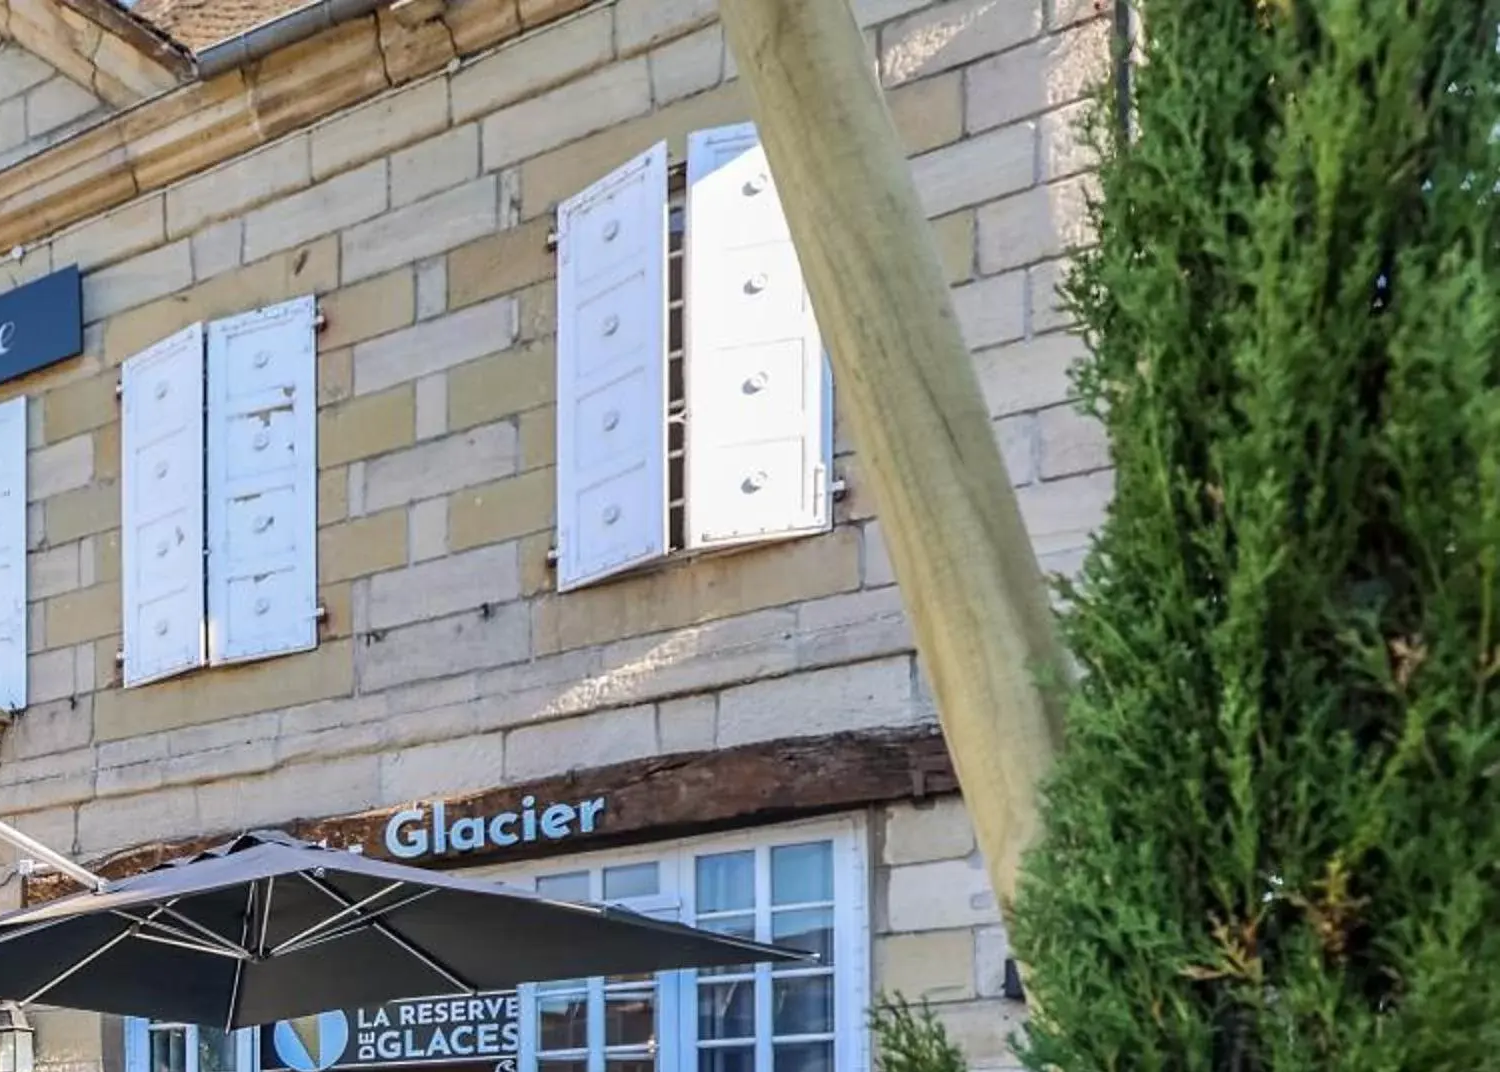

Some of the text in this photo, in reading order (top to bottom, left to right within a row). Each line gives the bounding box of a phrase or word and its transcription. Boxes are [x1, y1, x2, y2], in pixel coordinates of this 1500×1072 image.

[385, 795, 604, 858] Glacier
[357, 997, 519, 1029] LA RESERVE
[358, 1022, 519, 1060] DE GLACES
